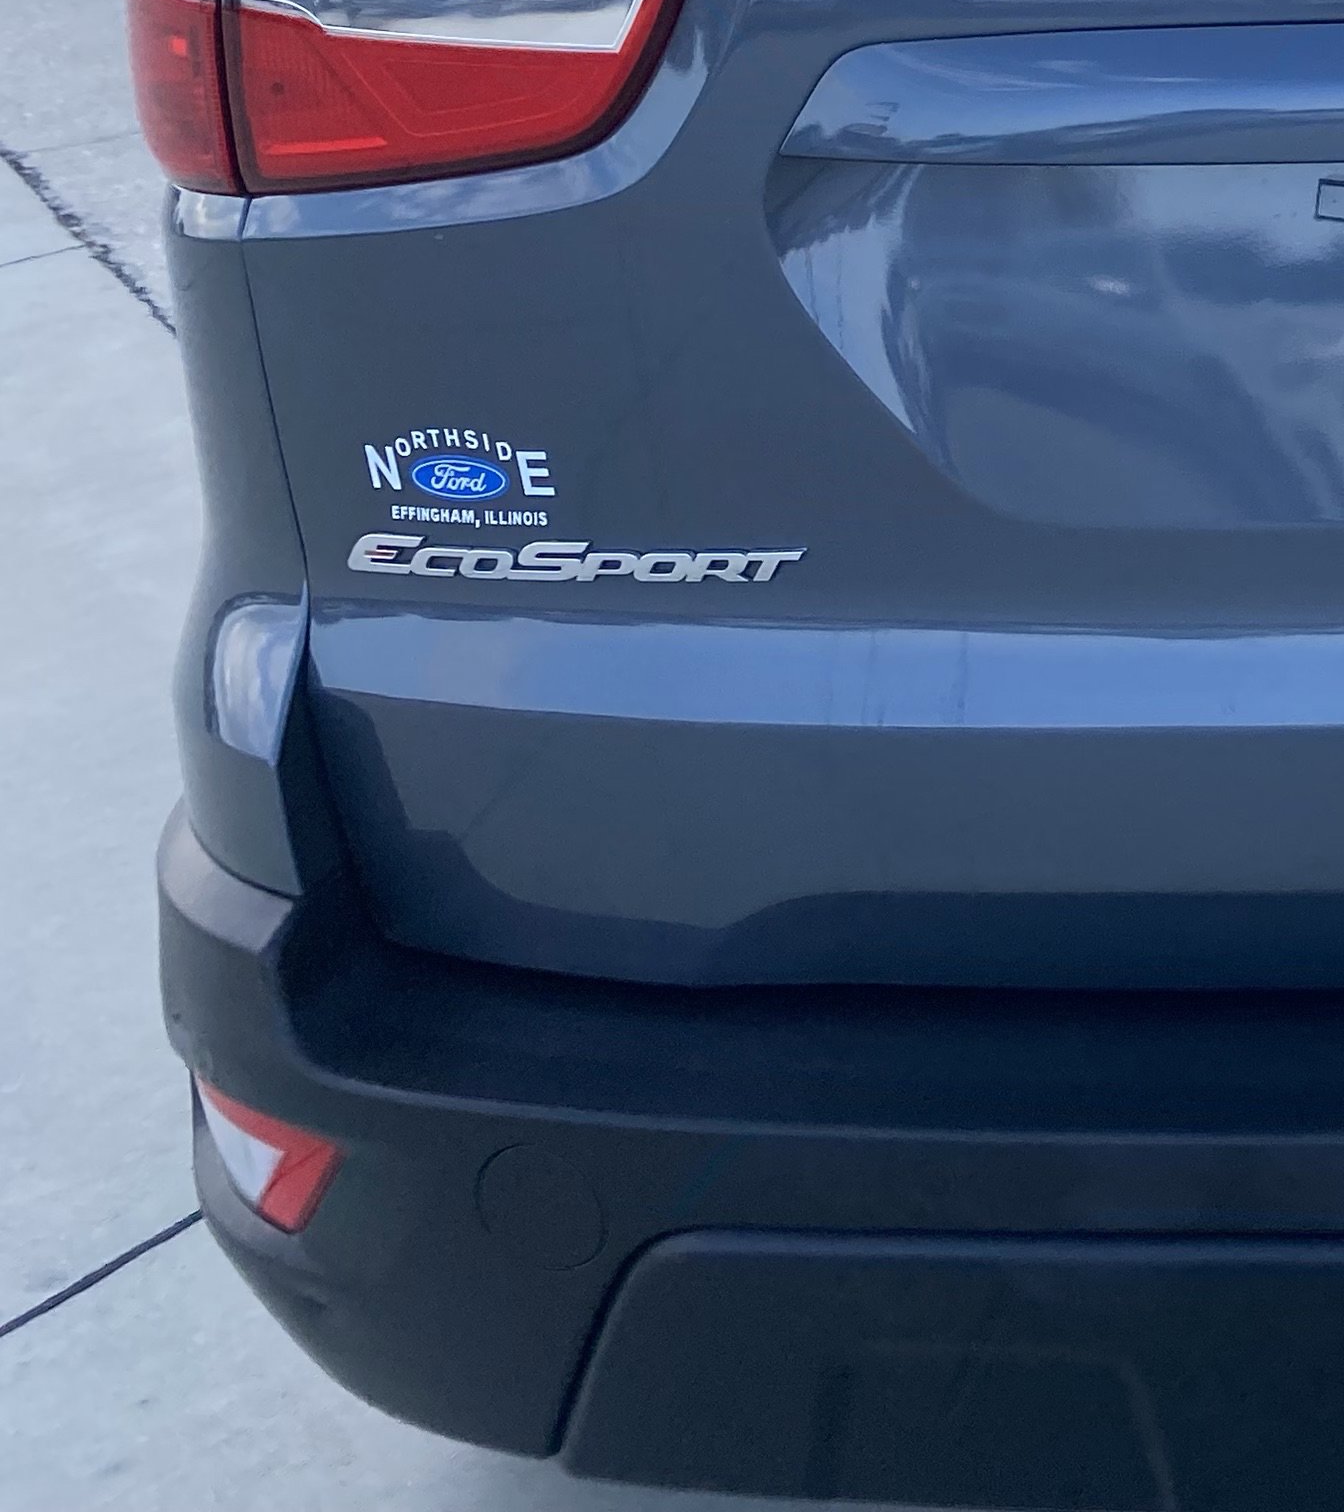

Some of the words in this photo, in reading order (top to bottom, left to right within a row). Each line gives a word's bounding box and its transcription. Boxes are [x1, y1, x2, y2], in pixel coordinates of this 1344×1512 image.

[364, 428, 555, 496] NORTHSIDE
[430, 463, 487, 492] Ford
[391, 505, 481, 528] EFFINGHAM,
[484, 511, 548, 527] ILLINOIS
